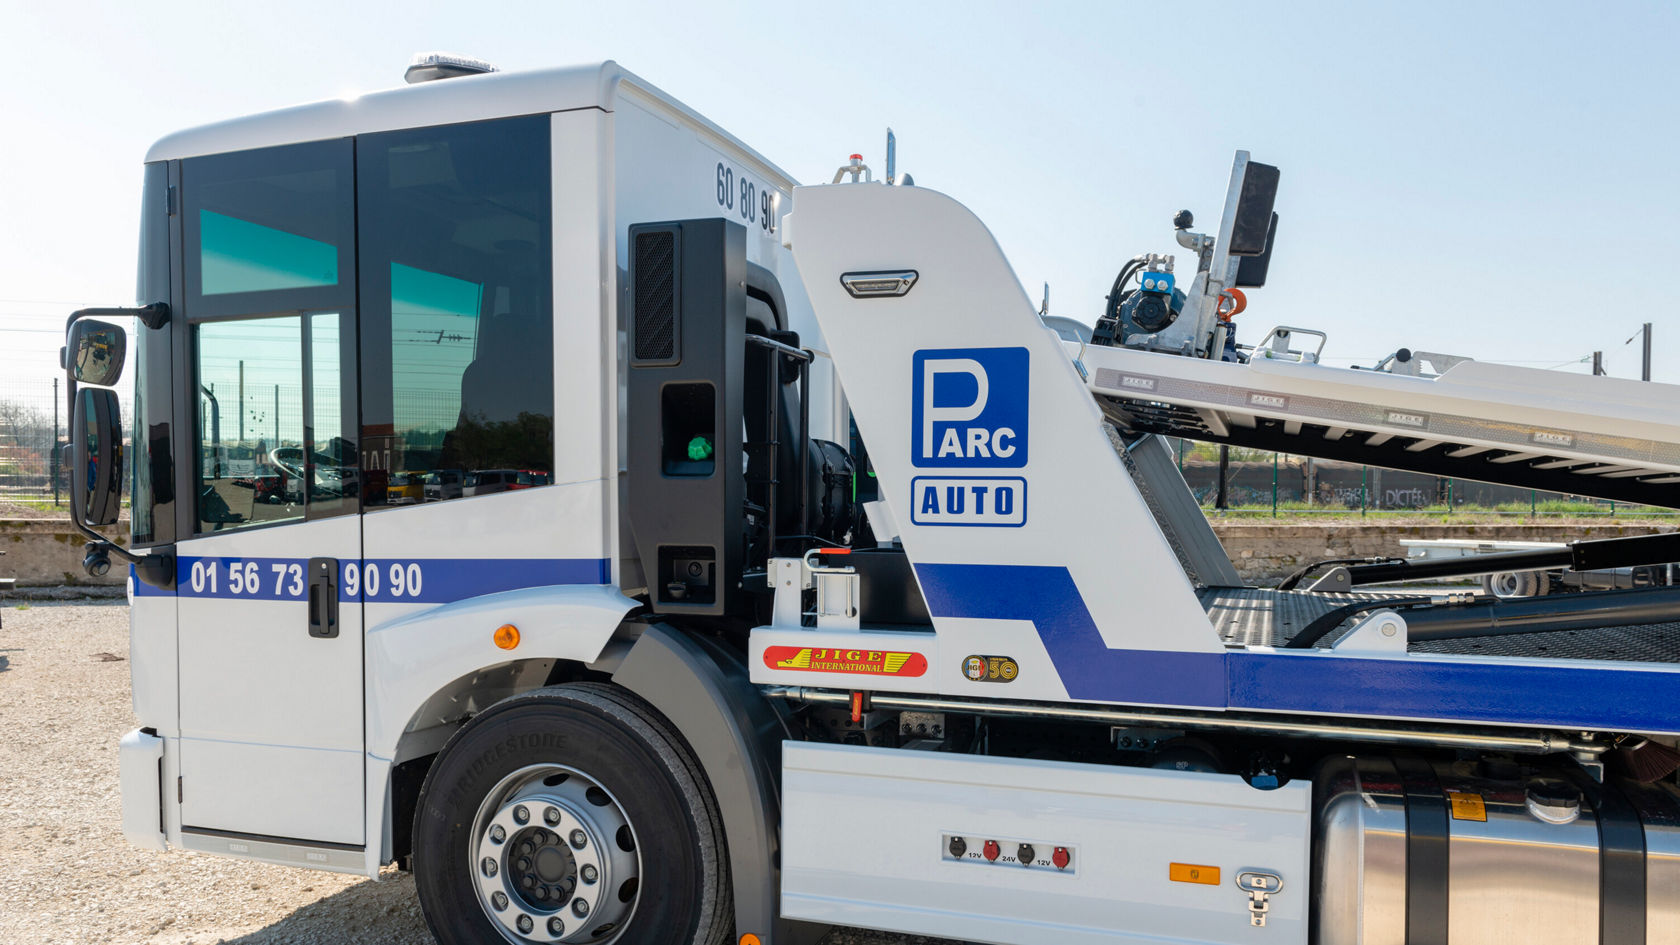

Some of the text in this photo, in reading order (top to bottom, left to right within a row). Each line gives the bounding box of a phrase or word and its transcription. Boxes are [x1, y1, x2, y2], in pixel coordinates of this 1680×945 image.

[717, 162, 775, 234] 60 80 90
[923, 358, 1016, 458] PARC
[921, 487, 1013, 515] AUTO
[191, 561, 422, 596] 01 56 73 90 90
[811, 661, 883, 673] INTERNATIONAL
[815, 649, 882, 662] JIGE
[990, 661, 1018, 679] 50
